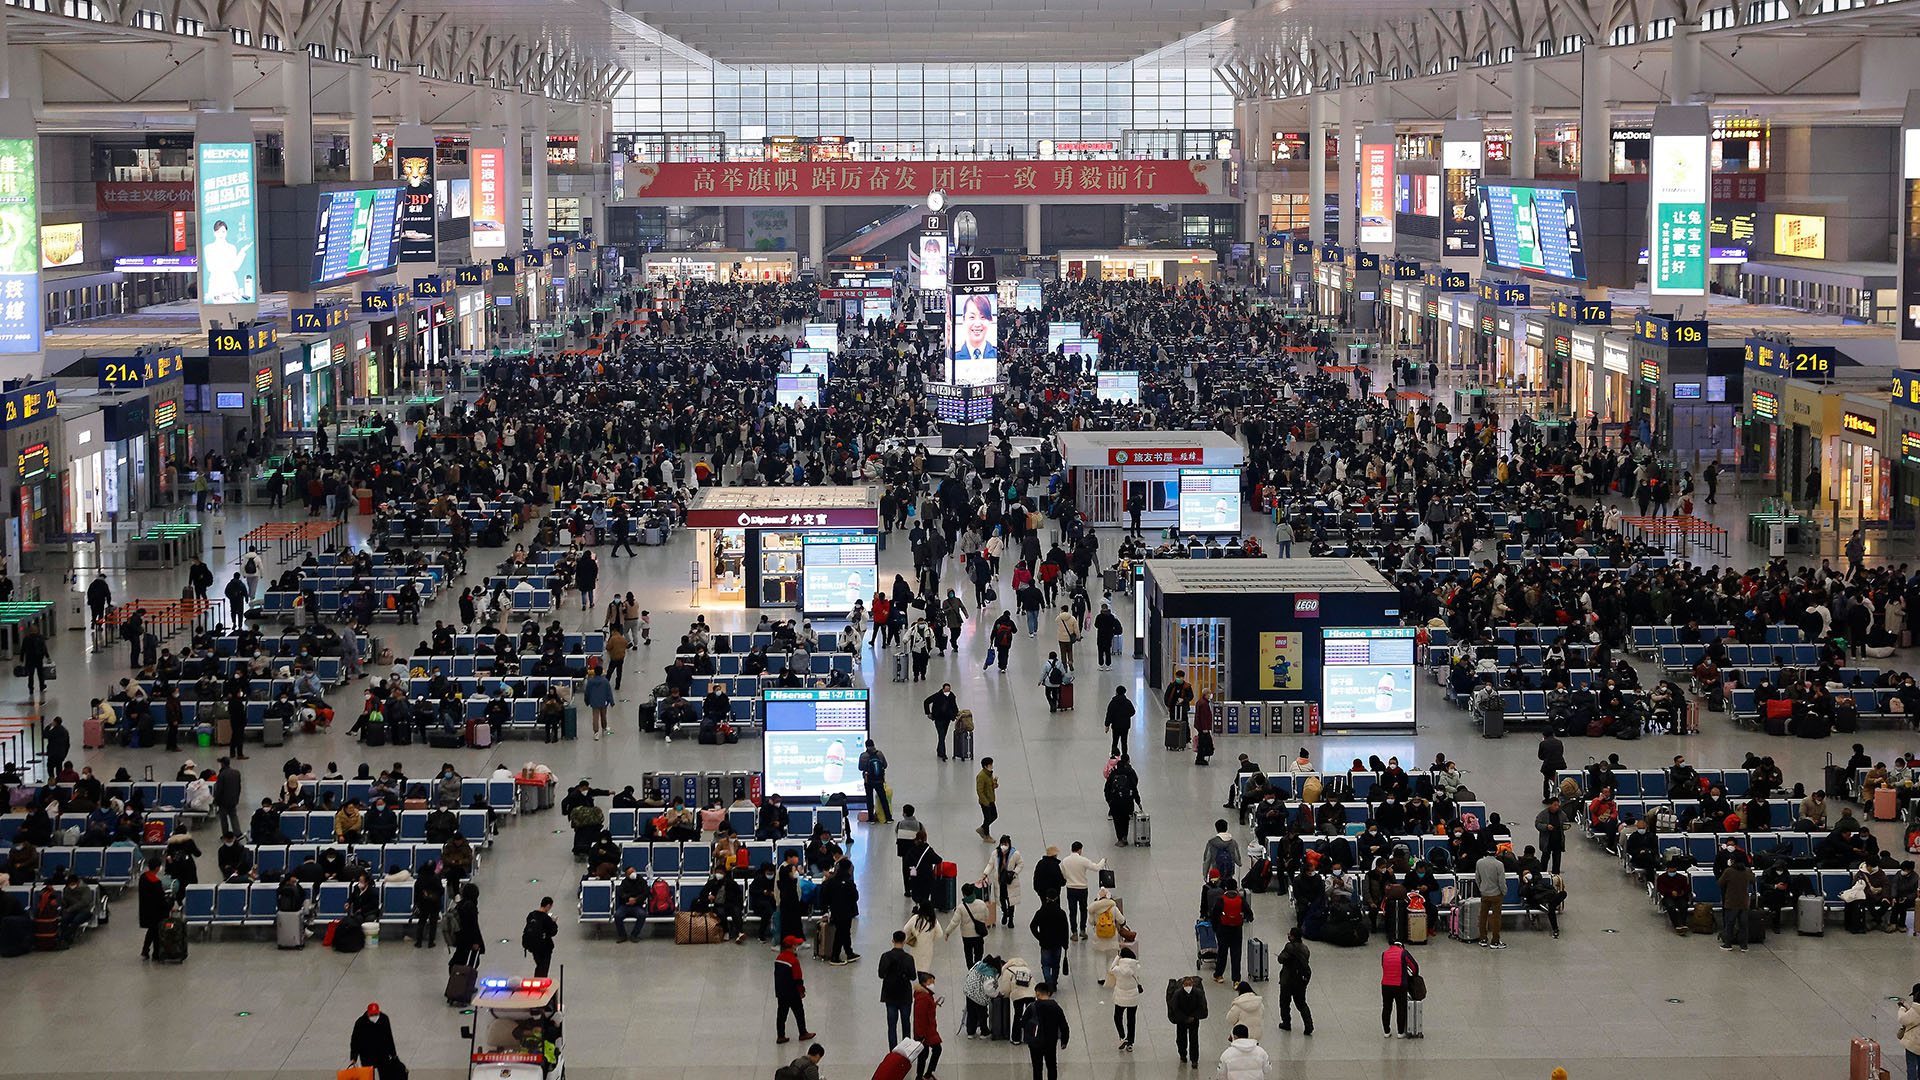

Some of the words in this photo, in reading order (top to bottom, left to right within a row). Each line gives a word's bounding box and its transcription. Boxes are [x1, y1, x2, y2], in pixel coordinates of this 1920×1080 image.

[693, 166, 799, 192] 高举旗帜
[811, 166, 918, 192] 踔厉奋发
[932, 165, 1038, 190] 团结一致
[1053, 164, 1157, 190] 勇毅前行
[480, 168, 496, 217] 浪鲸卫浴
[1688, 210, 1702, 257] 兔宝宝
[576, 241, 586, 250] 3A
[1672, 210, 1686, 274] 让家更好
[553, 248, 563, 256] 5A
[1298, 244, 1308, 252] 5B
[527, 254, 538, 264] 7A
[1328, 250, 1338, 260] 7B
[497, 262, 509, 272] 9A
[1362, 258, 1373, 267] 9B
[1400, 266, 1416, 276] 11B
[460, 272, 477, 282] 11A
[1446, 276, 1465, 288] 13B
[418, 282, 437, 293] 13A
[1504, 290, 1524, 301] 15B
[366, 296, 388, 308] 15A
[1582, 306, 1606, 320] 17B
[296, 314, 322, 328] 17A
[1674, 327, 1702, 342] 19B
[214, 335, 242, 350] 19A
[1796, 353, 1828, 371] 21B
[104, 364, 138, 382] 21A
[1134, 452, 1173, 462] 旅友书屋
[790, 514, 828, 526] 外交官
[1296, 599, 1319, 610] LEGO
[1328, 629, 1366, 638] Hisense
[770, 691, 813, 700] Hisense
